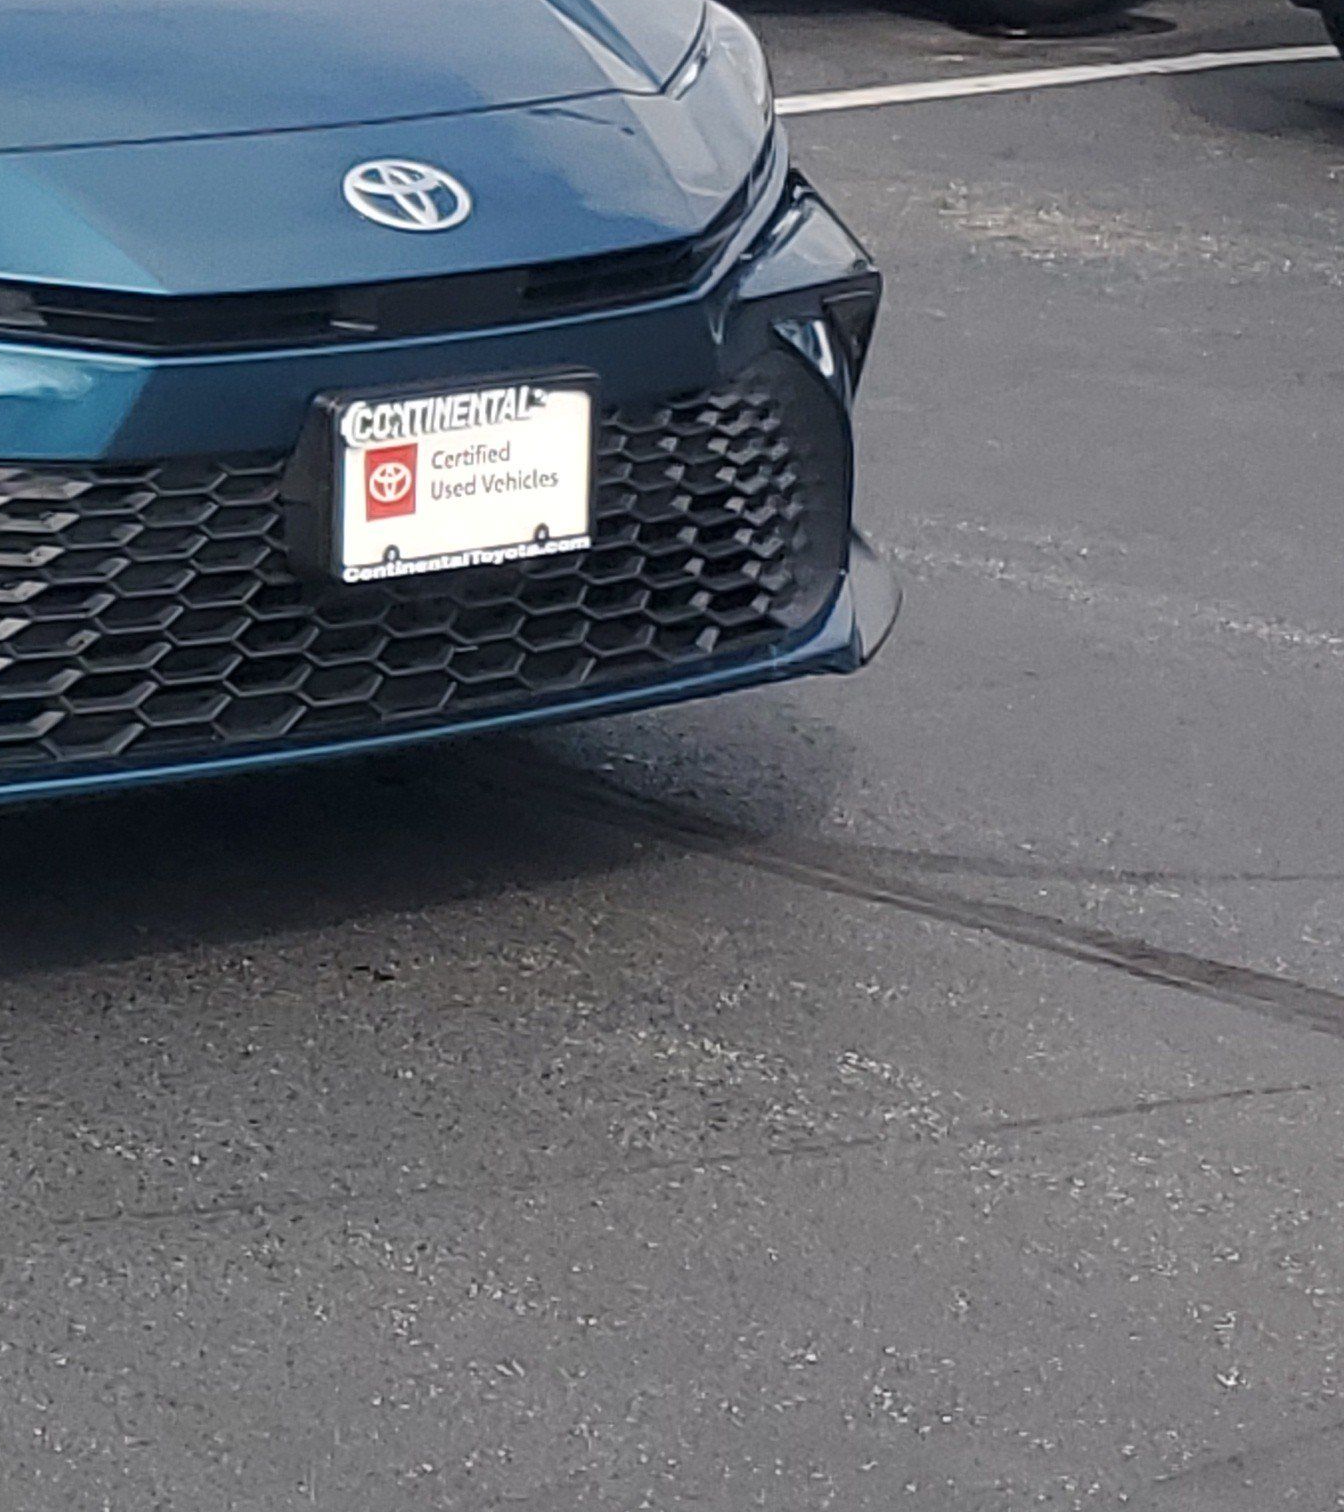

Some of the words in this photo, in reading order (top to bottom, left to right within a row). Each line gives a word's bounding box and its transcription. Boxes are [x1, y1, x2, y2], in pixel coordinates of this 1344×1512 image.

[342, 386, 532, 445] CONTINENTAL
[431, 441, 511, 470] Certified
[431, 475, 476, 500] Used
[481, 469, 559, 494] Vehicles
